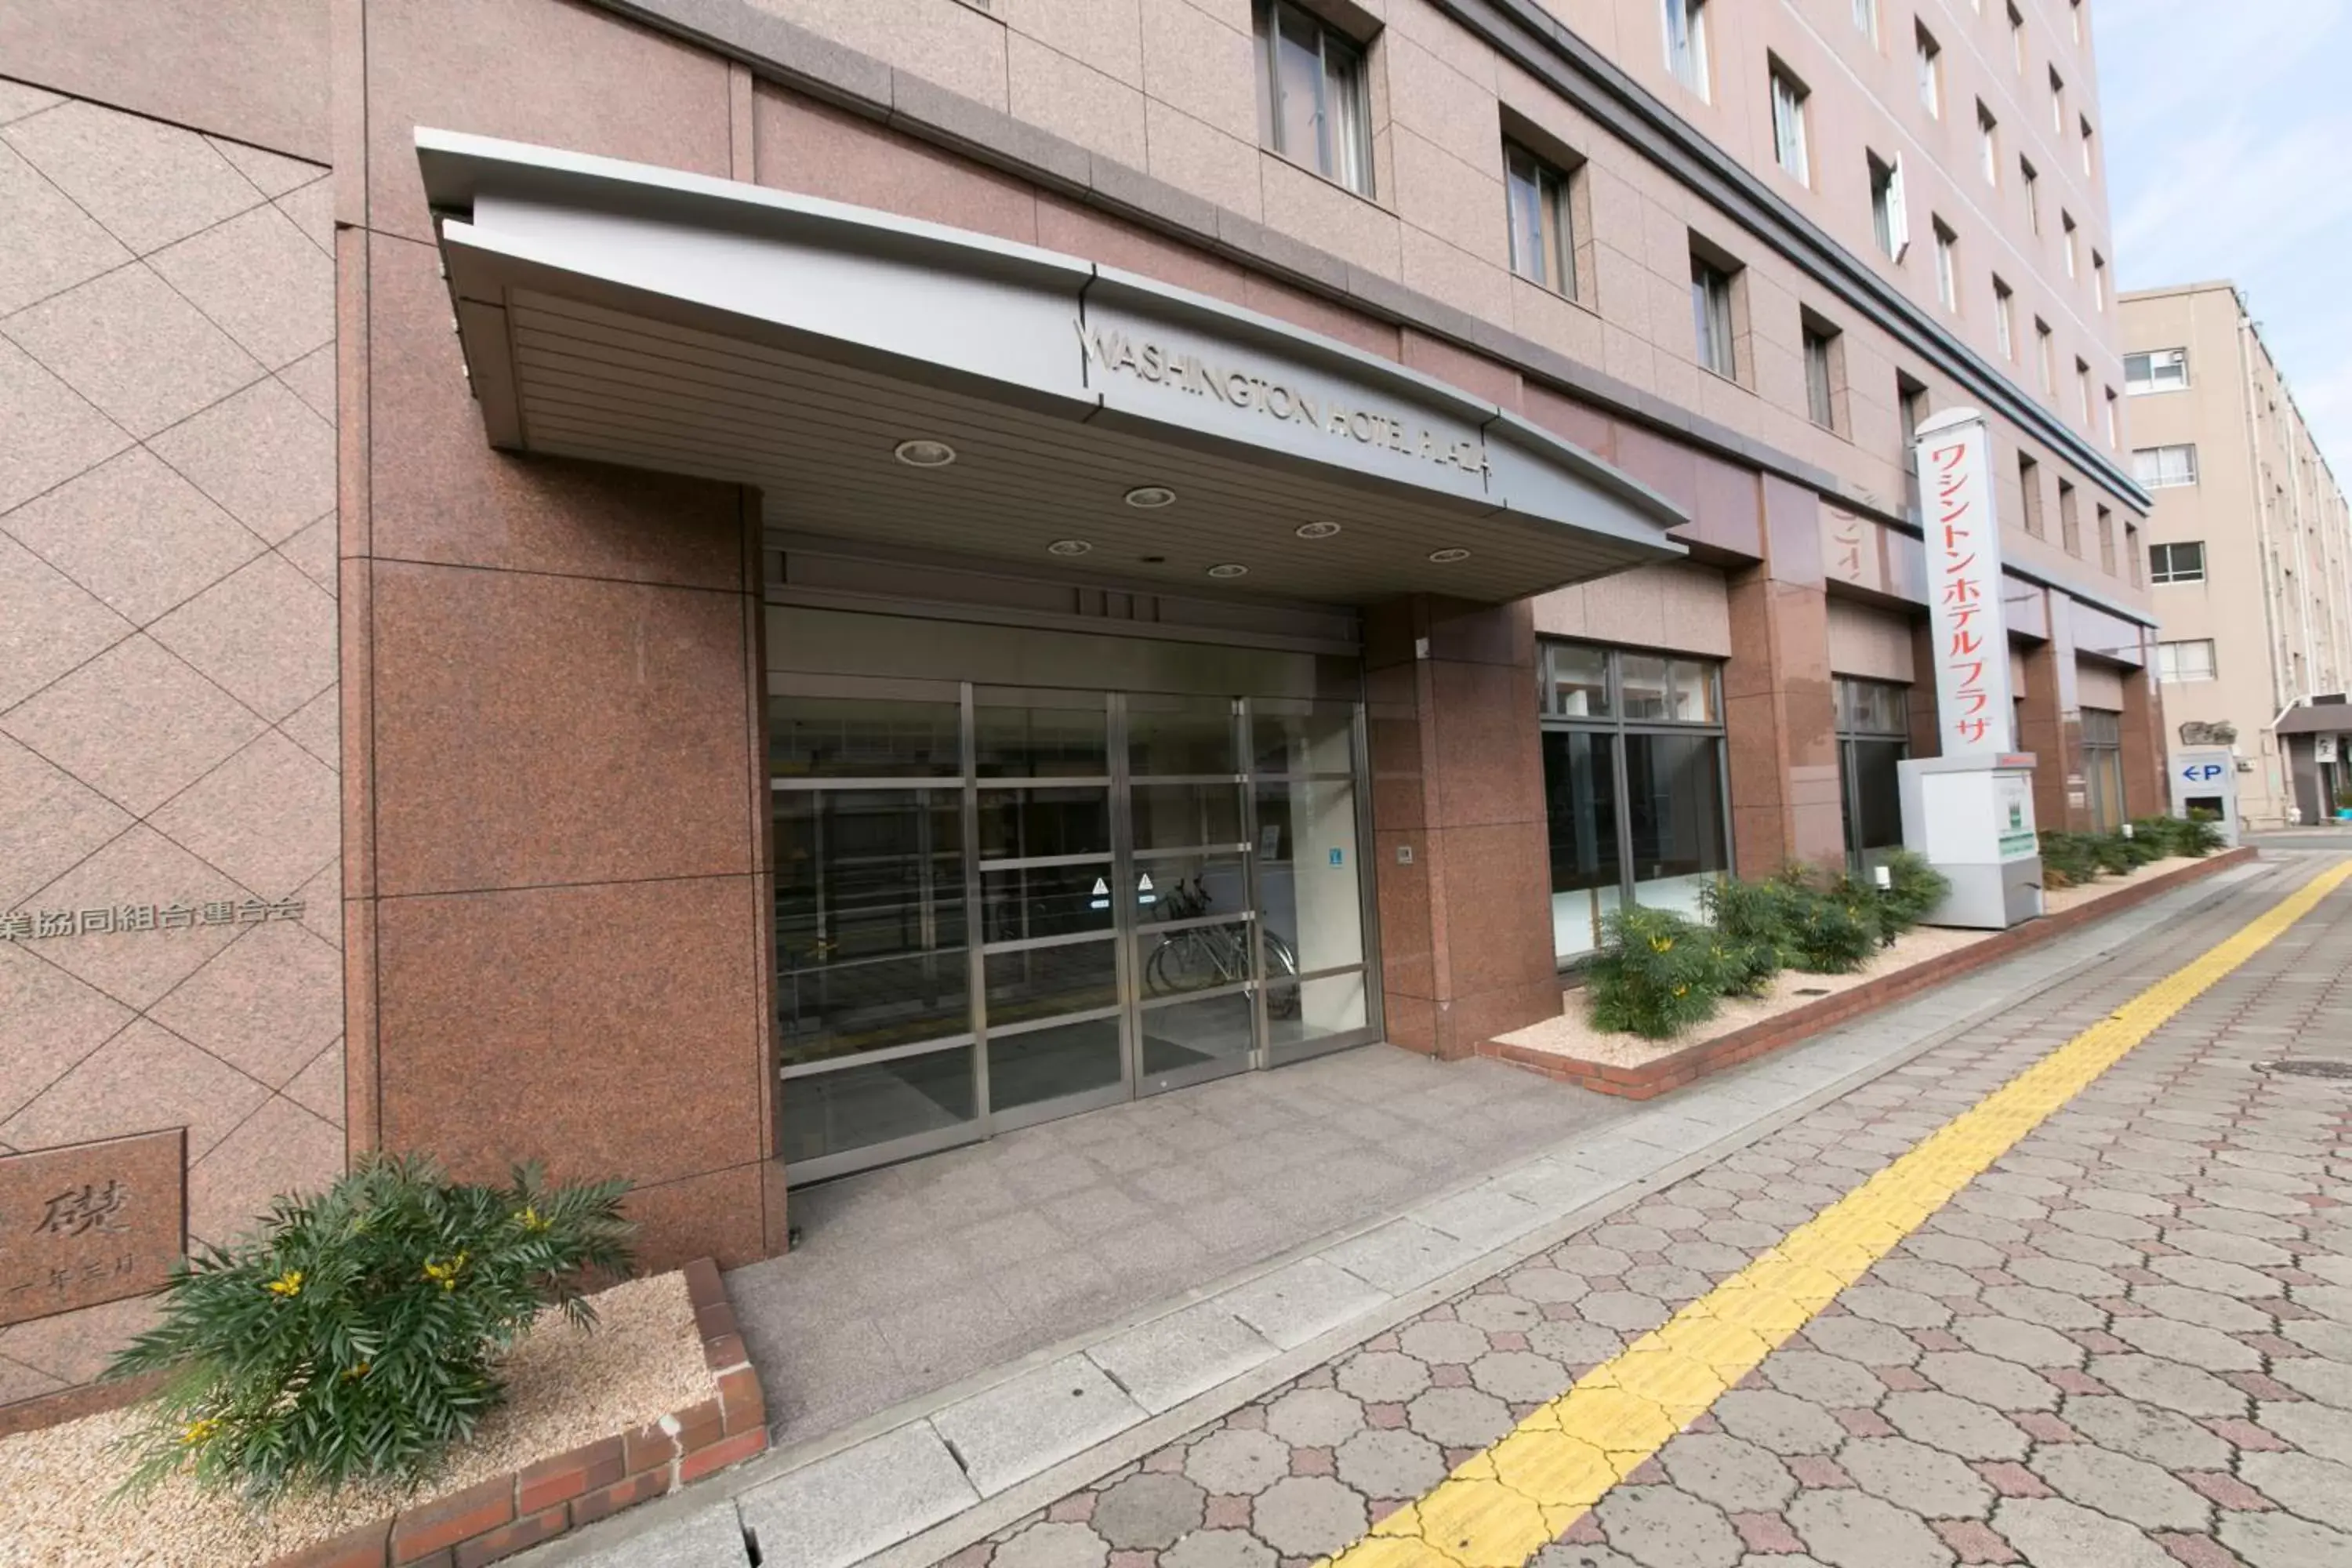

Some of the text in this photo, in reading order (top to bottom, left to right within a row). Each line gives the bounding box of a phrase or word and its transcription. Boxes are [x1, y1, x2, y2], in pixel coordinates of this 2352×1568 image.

[1072, 319, 1492, 477] WASHINGTON HOTEL PLAZA
[1932, 442, 1993, 743] ワシントンホテルプラザ
[2205, 764, 2221, 780] P
